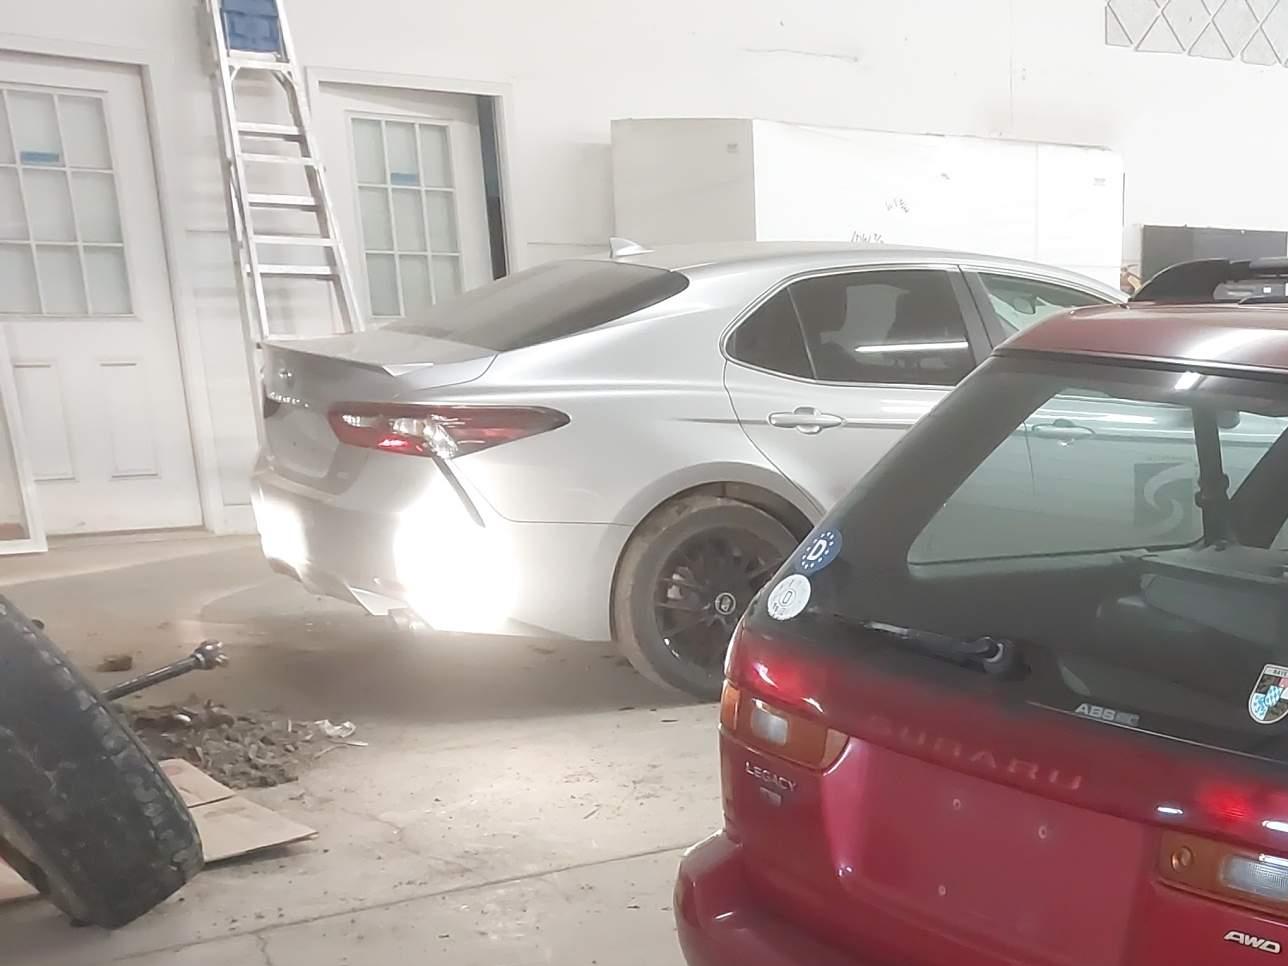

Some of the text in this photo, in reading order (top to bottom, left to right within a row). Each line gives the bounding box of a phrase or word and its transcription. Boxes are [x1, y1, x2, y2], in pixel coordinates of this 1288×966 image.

[806, 539, 828, 561] D
[1074, 703, 1116, 721] ABS
[745, 761, 797, 792] LEGACY
[1223, 930, 1281, 954] AWD
